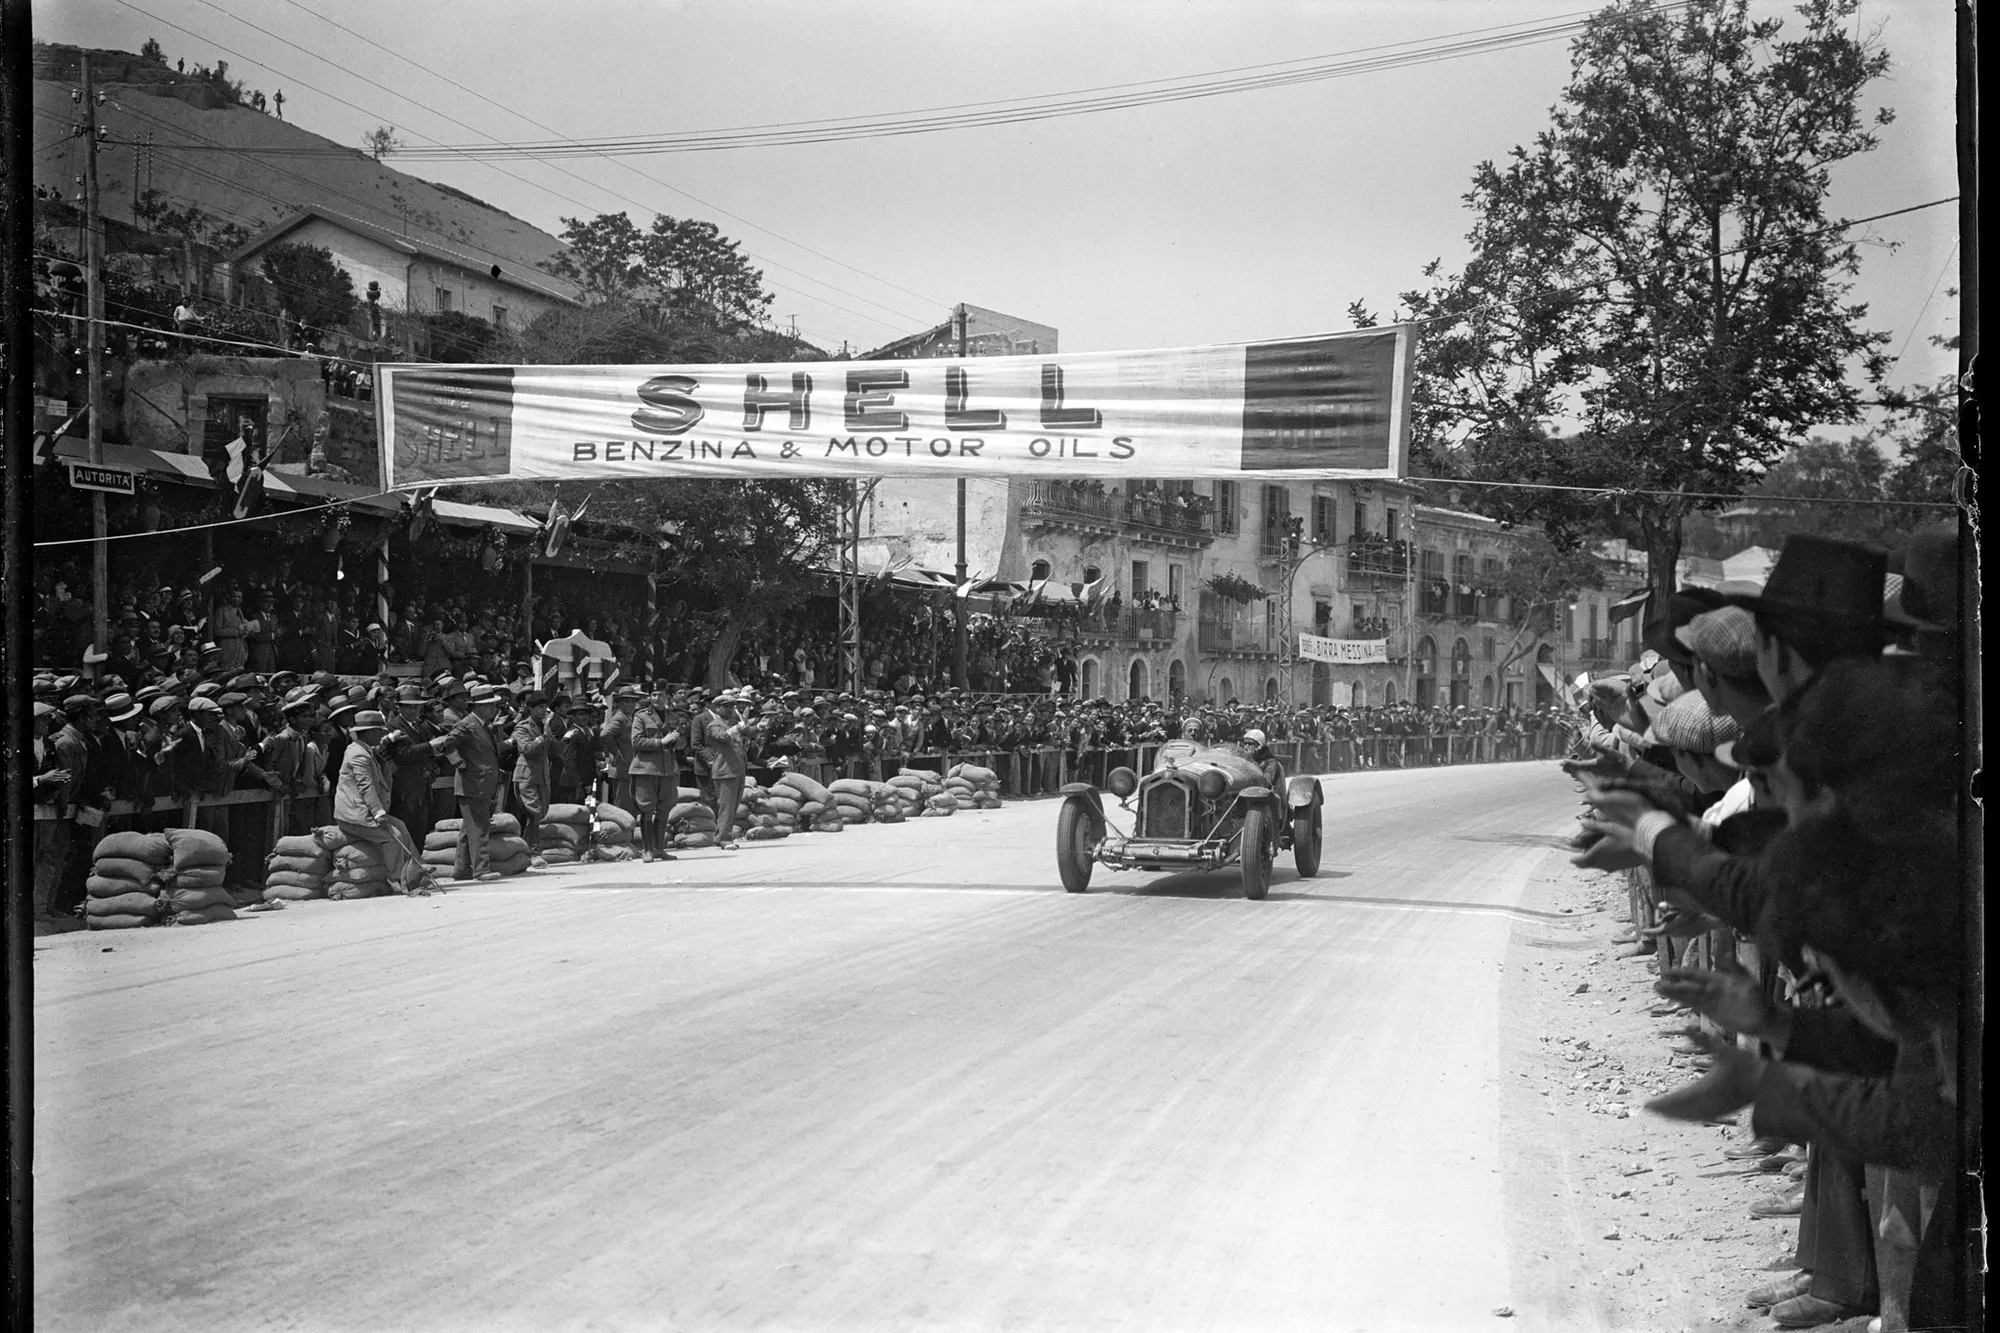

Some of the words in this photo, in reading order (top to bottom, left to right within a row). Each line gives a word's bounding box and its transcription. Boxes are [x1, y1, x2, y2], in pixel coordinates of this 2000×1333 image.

[631, 363, 1102, 435] SHELL
[400, 417, 507, 468] SHELL
[573, 440, 757, 461] BENZINA
[779, 441, 802, 459] &
[825, 436, 985, 457] MOTOR
[1028, 436, 1135, 459] OILS
[1316, 640, 1338, 658] BIRRA
[1340, 643, 1372, 660] MESSINA
